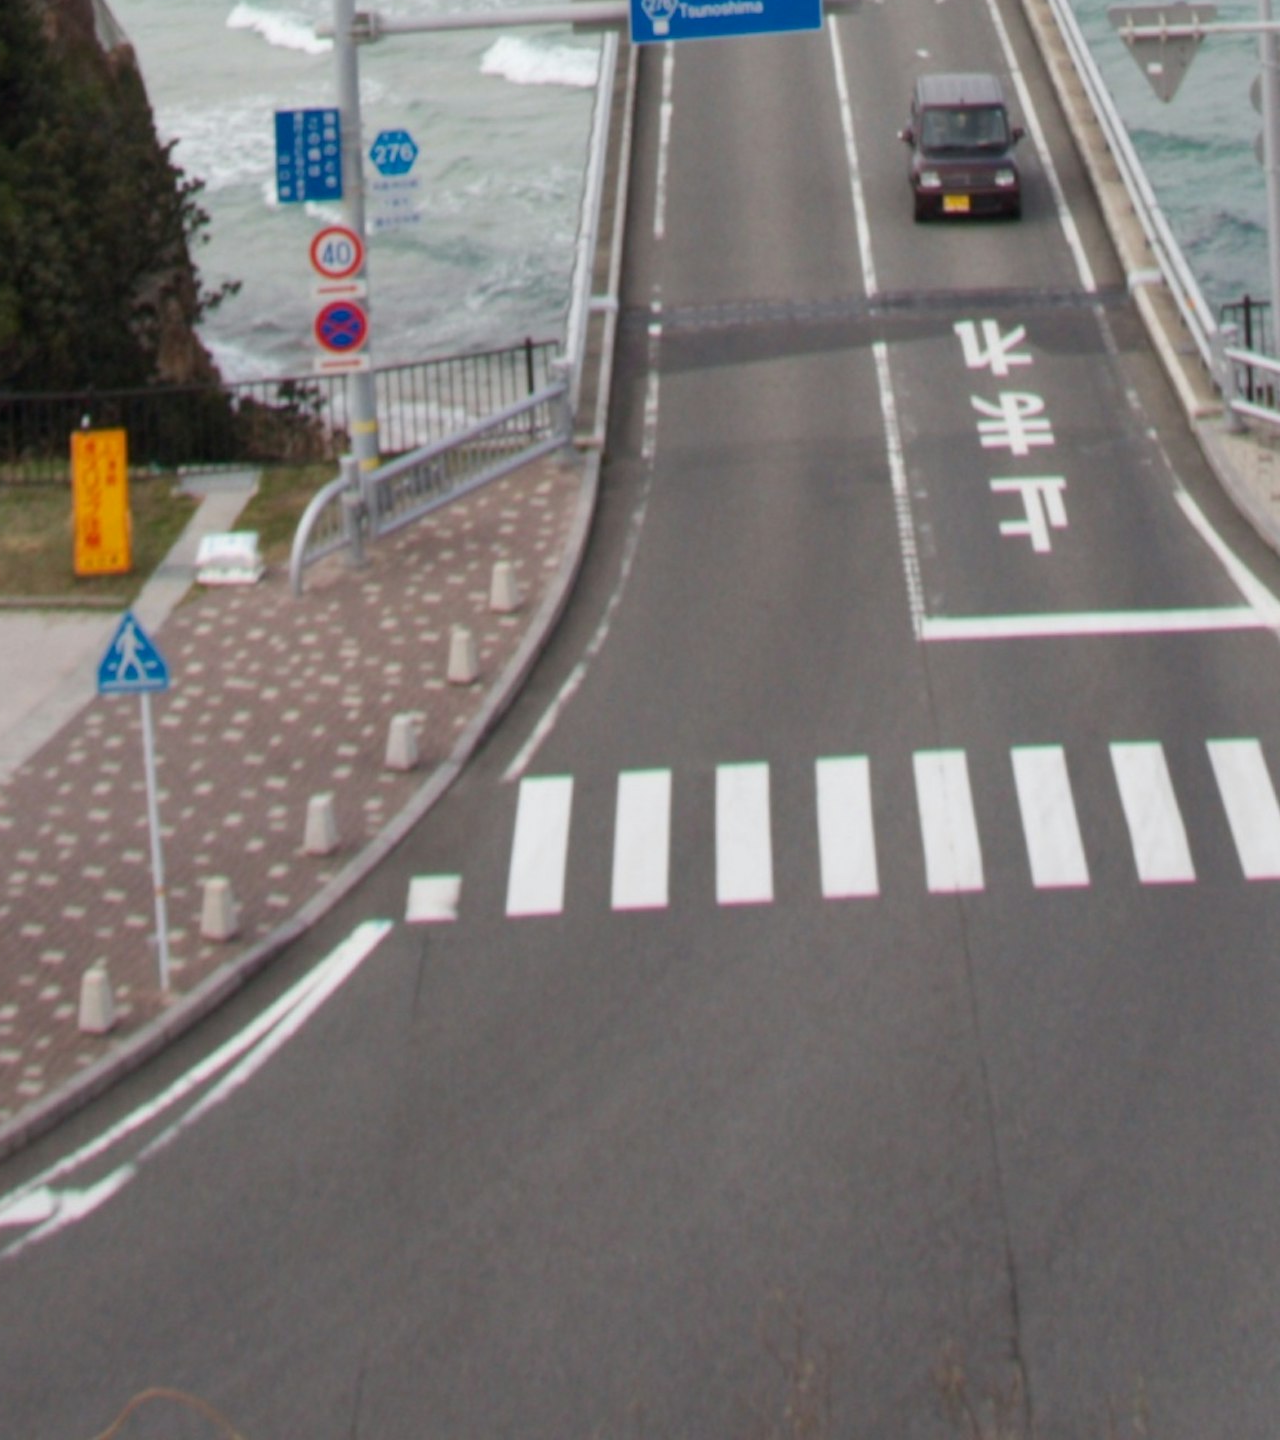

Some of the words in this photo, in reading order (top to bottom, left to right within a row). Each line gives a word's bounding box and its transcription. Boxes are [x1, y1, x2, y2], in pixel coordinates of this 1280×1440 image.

[680, 1, 763, 18] Tsunoshima
[374, 143, 413, 164] 276
[323, 242, 351, 265] 40
[953, 318, 1068, 553] 止まれ
